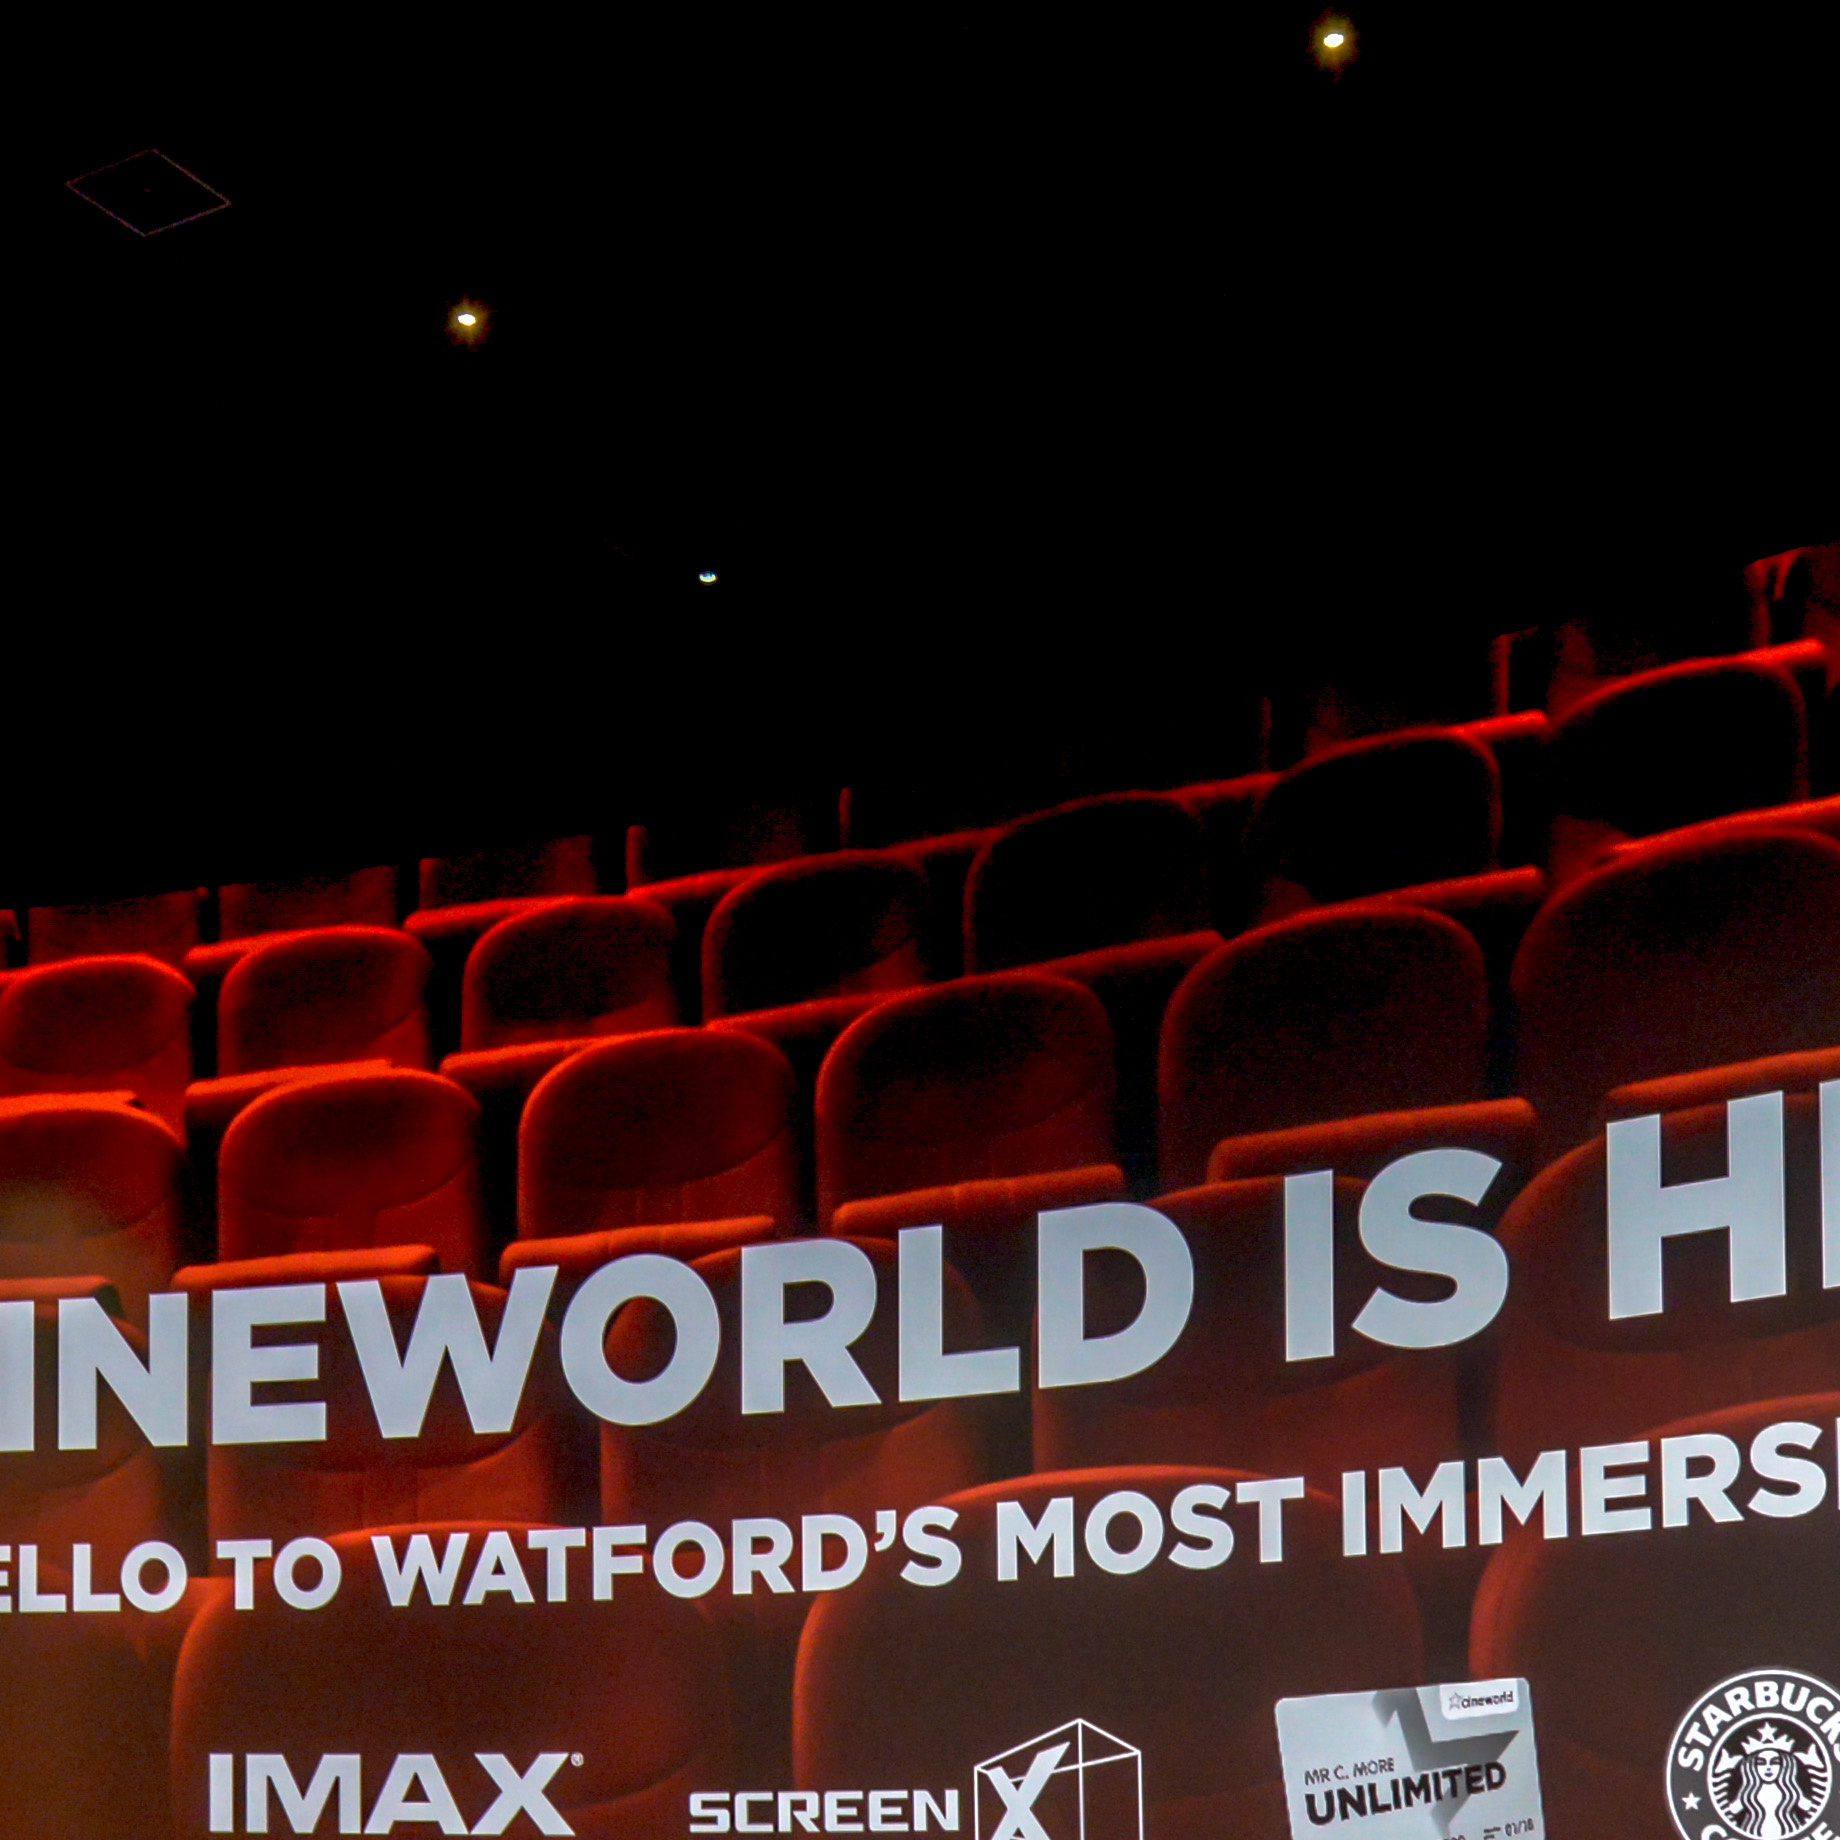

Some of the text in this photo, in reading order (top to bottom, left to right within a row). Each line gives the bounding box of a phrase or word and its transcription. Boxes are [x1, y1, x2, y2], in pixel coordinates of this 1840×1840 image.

[1284, 1147, 1509, 1363] IS
[216, 1536, 342, 1610] TO
[996, 1476, 1306, 1582] MOST
[1304, 1757, 1395, 1786] MR C. MORE
[1304, 1761, 1507, 1826] UNLIMITED
[689, 1788, 960, 1834] SCREEN
